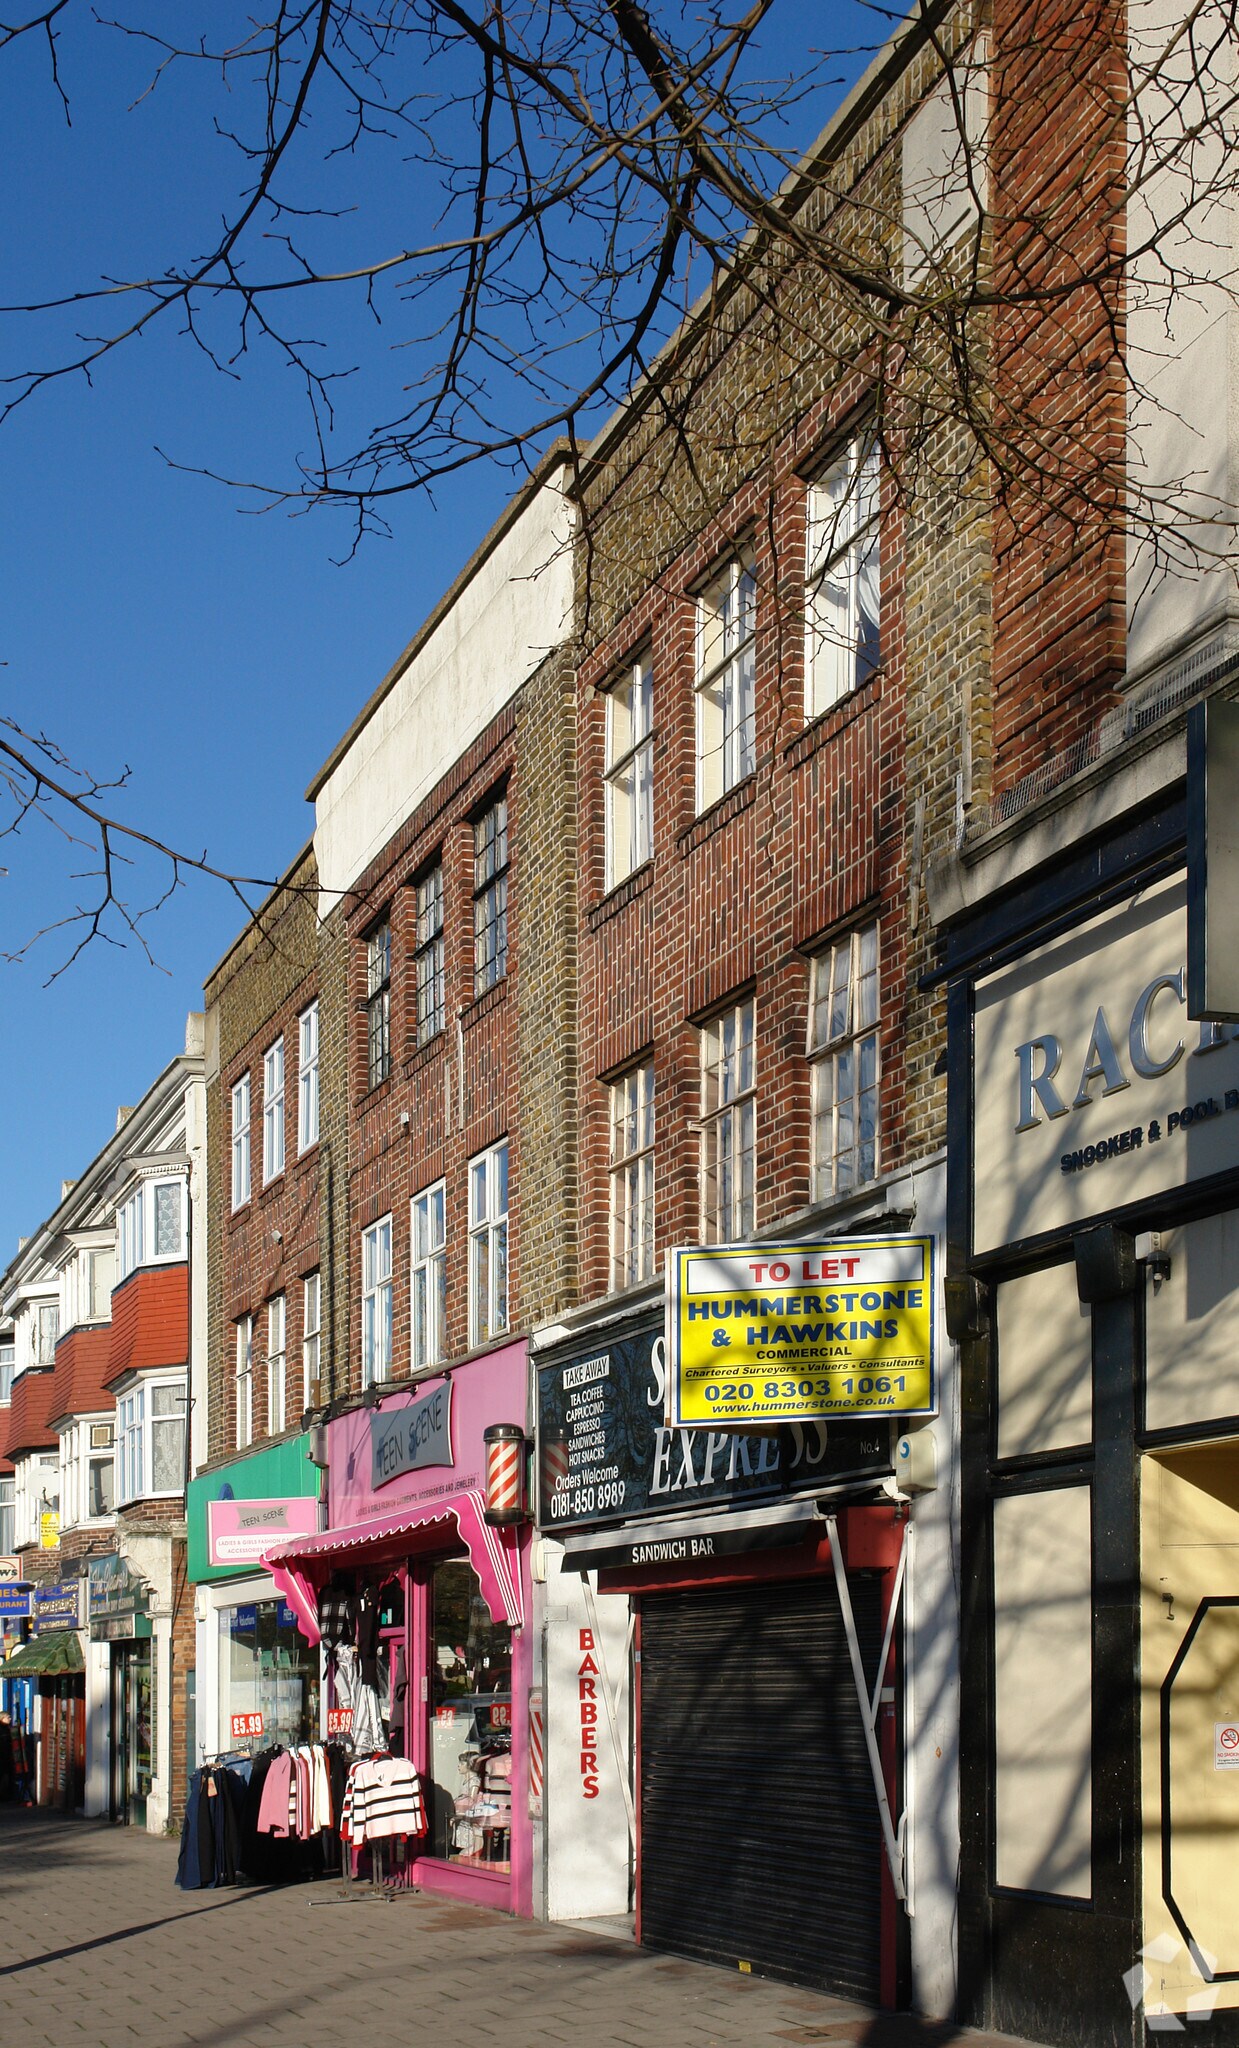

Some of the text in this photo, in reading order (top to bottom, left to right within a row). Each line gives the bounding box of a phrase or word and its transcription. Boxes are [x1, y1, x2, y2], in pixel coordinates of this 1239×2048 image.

[1060, 1127, 1143, 1174] SNOOKER
[1148, 1120, 1160, 1141] &
[1167, 1098, 1219, 1134] POOL
[749, 1257, 860, 1283] TO LET
[687, 1289, 923, 1321] HUMMERSTONE
[711, 1319, 899, 1347] & HAWKINS
[756, 1347, 852, 1360] COMMERCIAL
[565, 1357, 608, 1387] TAKE AWAY
[685, 1358, 926, 1378] Chartered Surveyors Valuers Consultants
[570, 1385, 604, 1407] TEA COFFEE
[704, 1376, 906, 1401] 020 8303 1061
[565, 1400, 605, 1423] CAPPUCCINO
[711, 1395, 897, 1414] www.hummerstone.co.uk
[376, 1394, 442, 1478] TEEN SCENE
[573, 1417, 601, 1436] ESPRESSO
[568, 1430, 606, 1452] SANDWICHES
[860, 1438, 880, 1455] No.4
[568, 1446, 606, 1467] HOT SNACKS
[555, 1465, 619, 1492] Orders Welcome
[418, 1484, 445, 1501] ACCESSORIES
[445, 1480, 455, 1494] AND
[550, 1480, 626, 1519] 0181-850 8989
[242, 1507, 285, 1528] TEEN SCENE
[228, 1547, 263, 1555] ACCESSORIES
[632, 1537, 714, 1563] SANDWICH BAR
[233, 1715, 262, 1734] £5.99
[328, 1711, 352, 1732] £5.99
[577, 1628, 600, 1799] BARBERS
